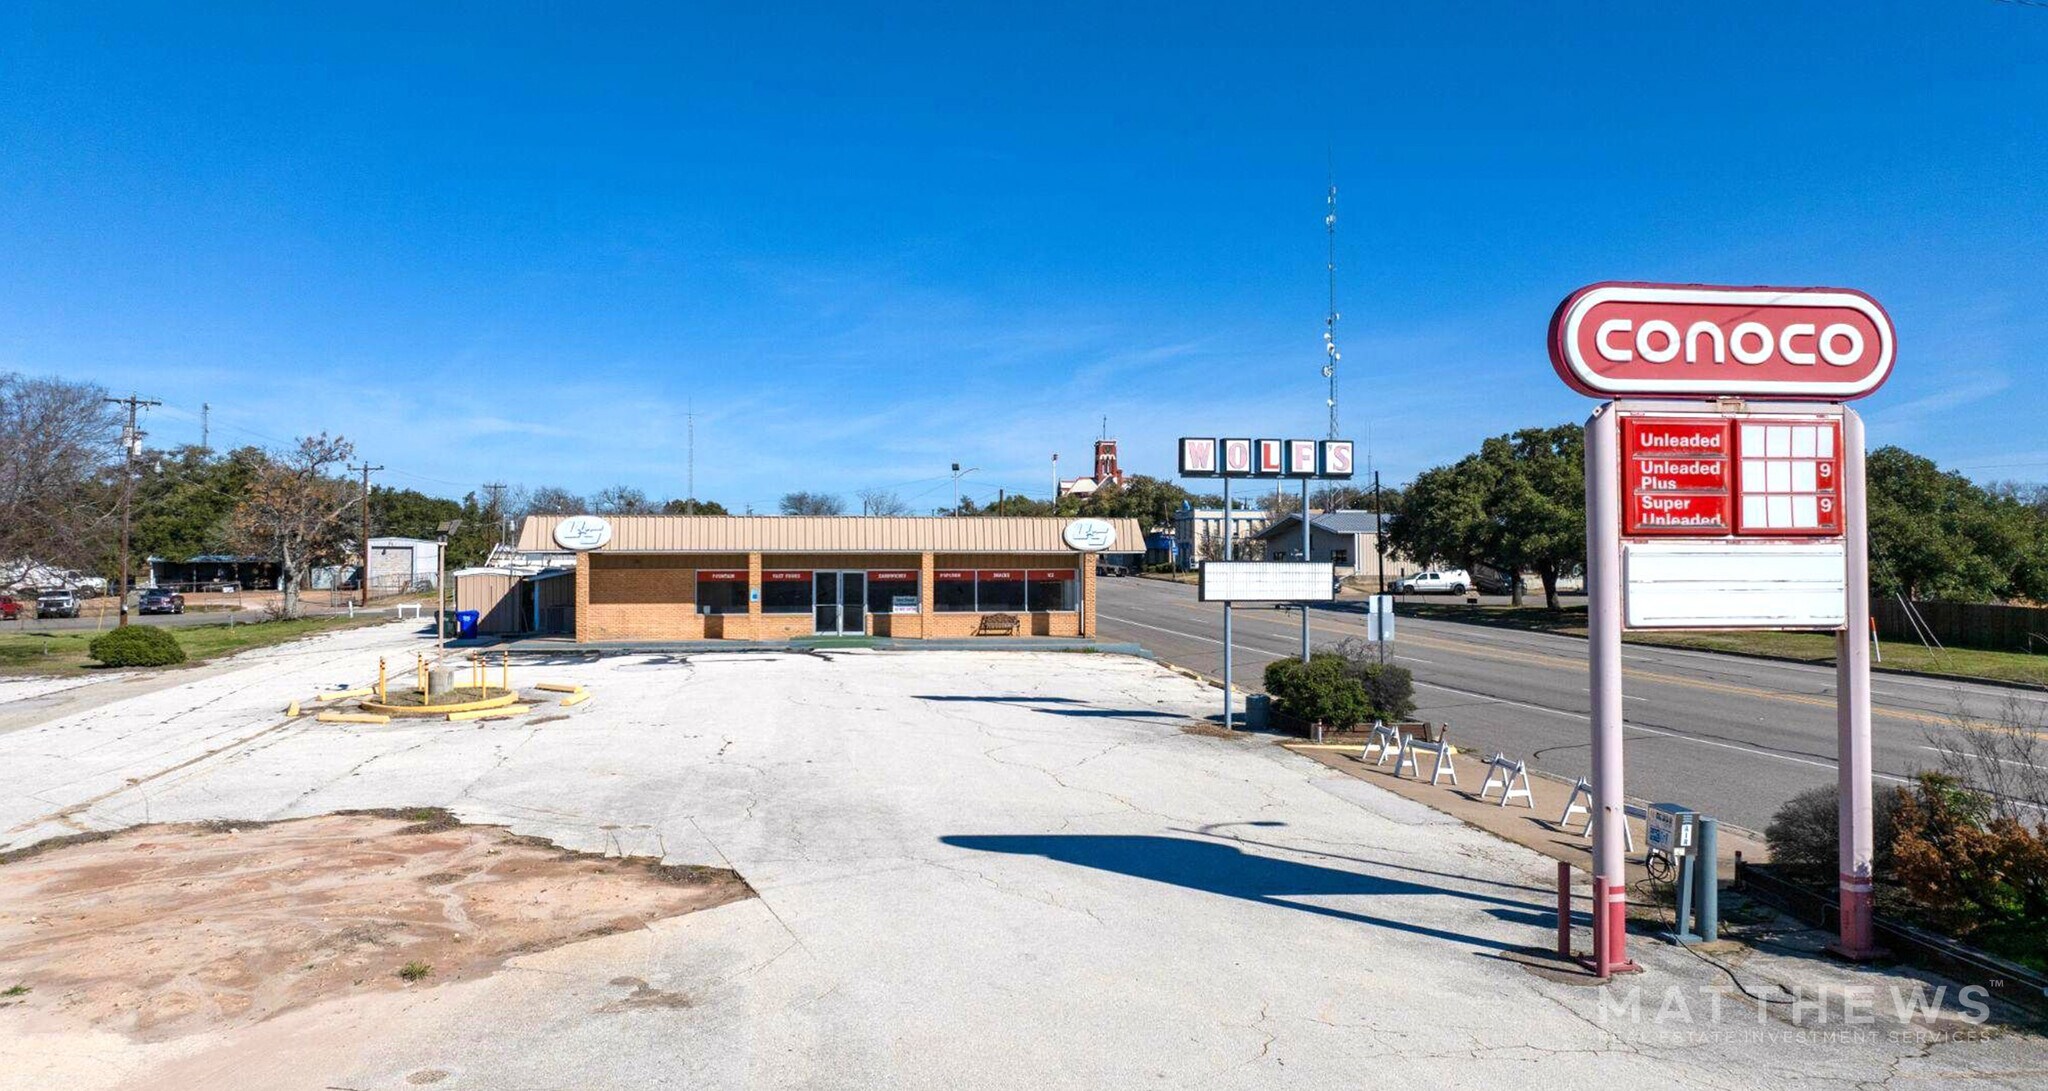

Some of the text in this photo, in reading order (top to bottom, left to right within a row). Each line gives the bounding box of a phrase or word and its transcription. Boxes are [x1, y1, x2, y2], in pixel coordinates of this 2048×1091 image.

[1595, 319, 1865, 366] CONOCO
[1640, 432, 1721, 448] Unleaded
[1187, 441, 1350, 472] WOLF'S
[1641, 460, 1721, 475] Unleaded
[1819, 463, 1831, 478] 9
[1641, 476, 1677, 490] Plus
[1641, 495, 1691, 513] Super
[1820, 498, 1832, 513] 9
[1642, 512, 1723, 525] Unleaded
